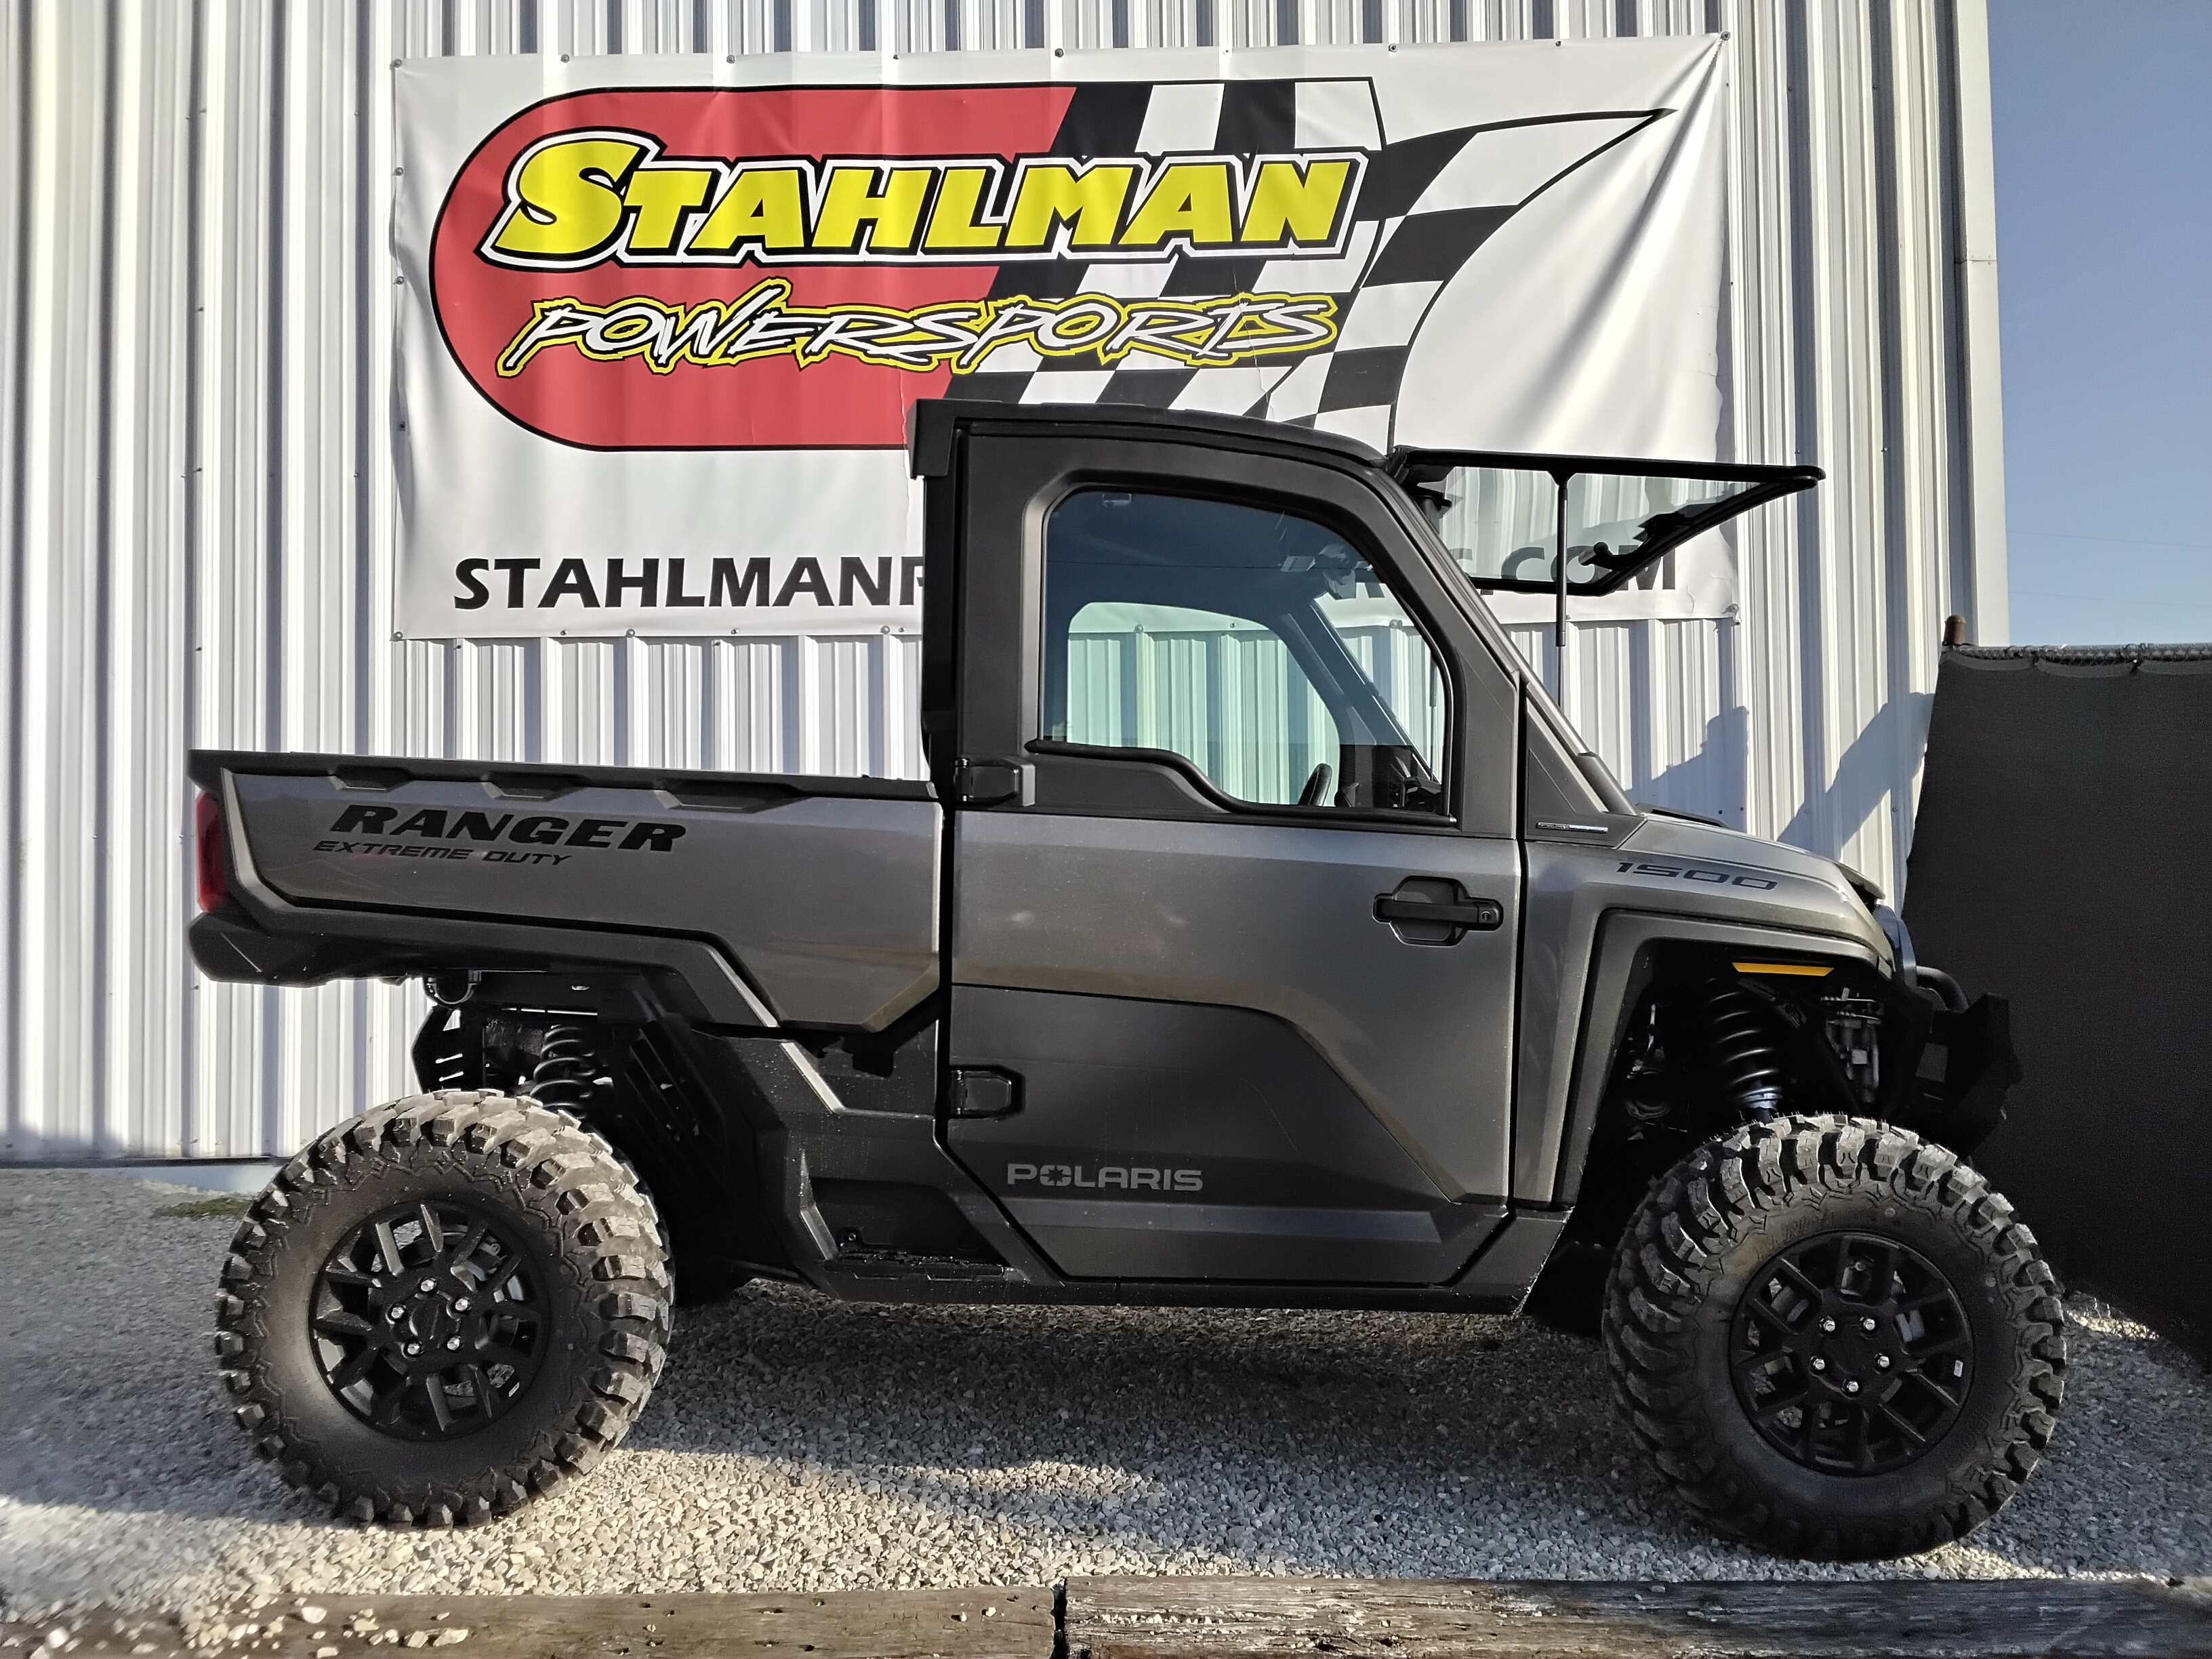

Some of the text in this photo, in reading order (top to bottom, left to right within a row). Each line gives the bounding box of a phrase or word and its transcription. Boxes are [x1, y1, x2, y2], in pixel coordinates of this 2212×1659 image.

[478, 129, 1369, 268] STAHLMAN
[496, 277, 1339, 377] POWERSPORTS
[330, 804, 687, 852] RANGER
[312, 840, 573, 866] EXTREME DUTY
[1616, 861, 1778, 890] 1500
[1006, 1163, 1204, 1191] POLARIS
